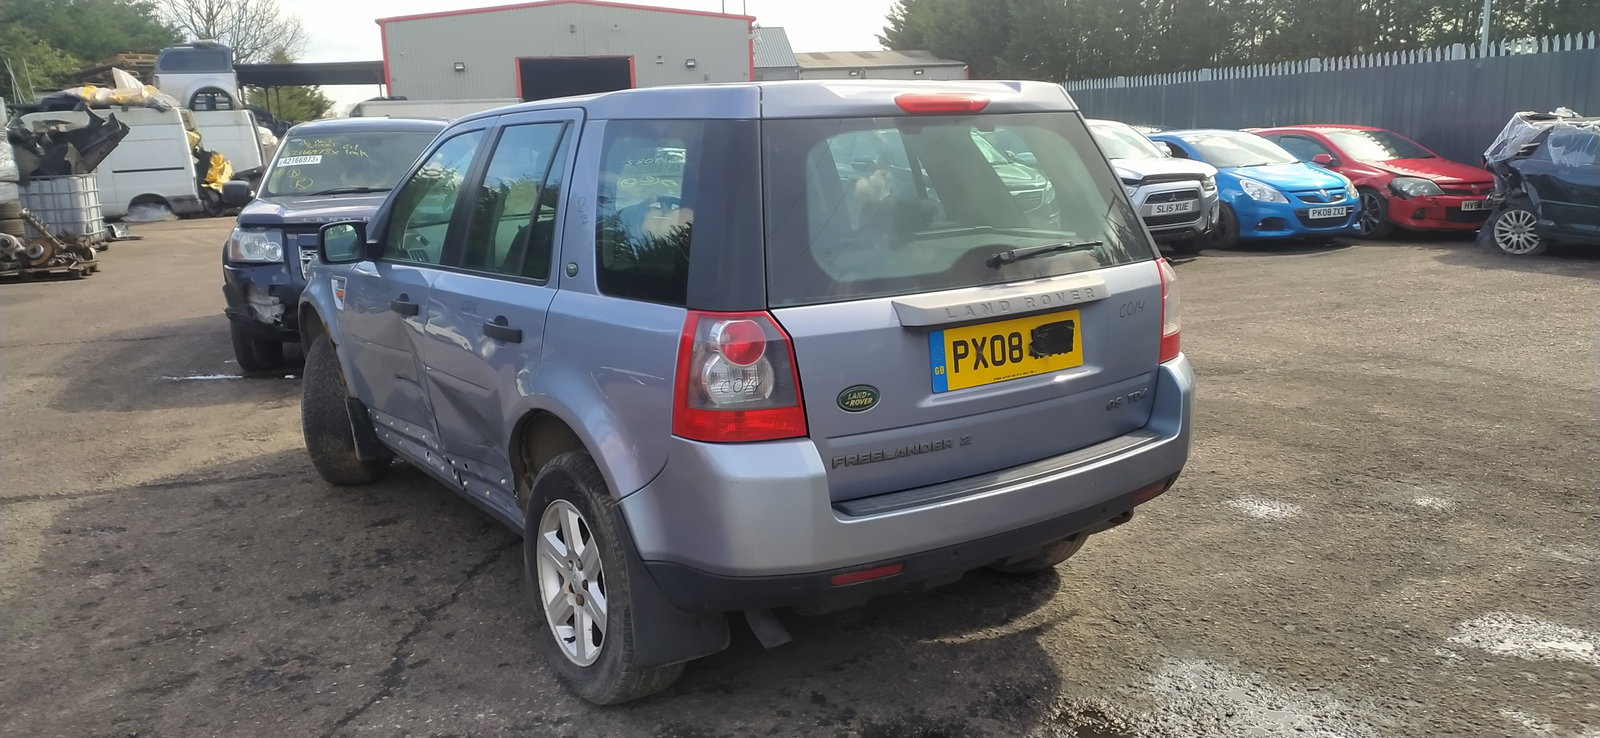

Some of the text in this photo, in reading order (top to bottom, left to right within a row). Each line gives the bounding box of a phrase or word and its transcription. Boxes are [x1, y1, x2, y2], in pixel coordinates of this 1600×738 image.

[1156, 201, 1190, 214] SL15 XUE
[1312, 207, 1345, 218] PK08 ZXZ
[945, 287, 1096, 321] LAND ROVER
[952, 331, 1024, 374] PX08
[934, 365, 945, 376] GB
[847, 390, 868, 400] LAND
[849, 396, 874, 407] ROVER
[831, 433, 972, 470] FREELANDER 2
